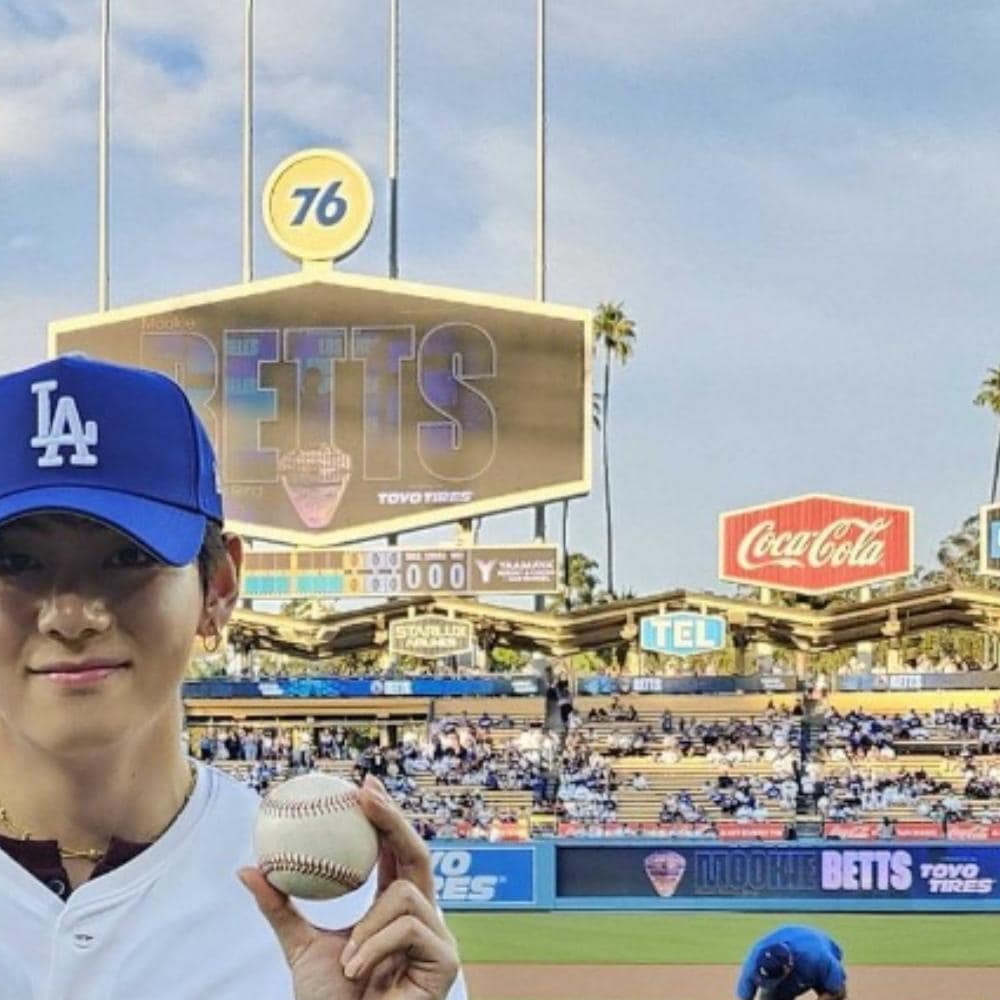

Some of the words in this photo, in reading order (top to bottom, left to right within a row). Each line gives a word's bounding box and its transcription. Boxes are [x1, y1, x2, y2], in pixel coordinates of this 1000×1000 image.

[289, 181, 348, 226] 76
[30, 380, 98, 467] LA
[377, 491, 422, 504] TOYO
[651, 619, 715, 649] TEL
[821, 850, 912, 890] BETTS
[920, 863, 979, 879] TOYO
[929, 879, 993, 893] TIRES
